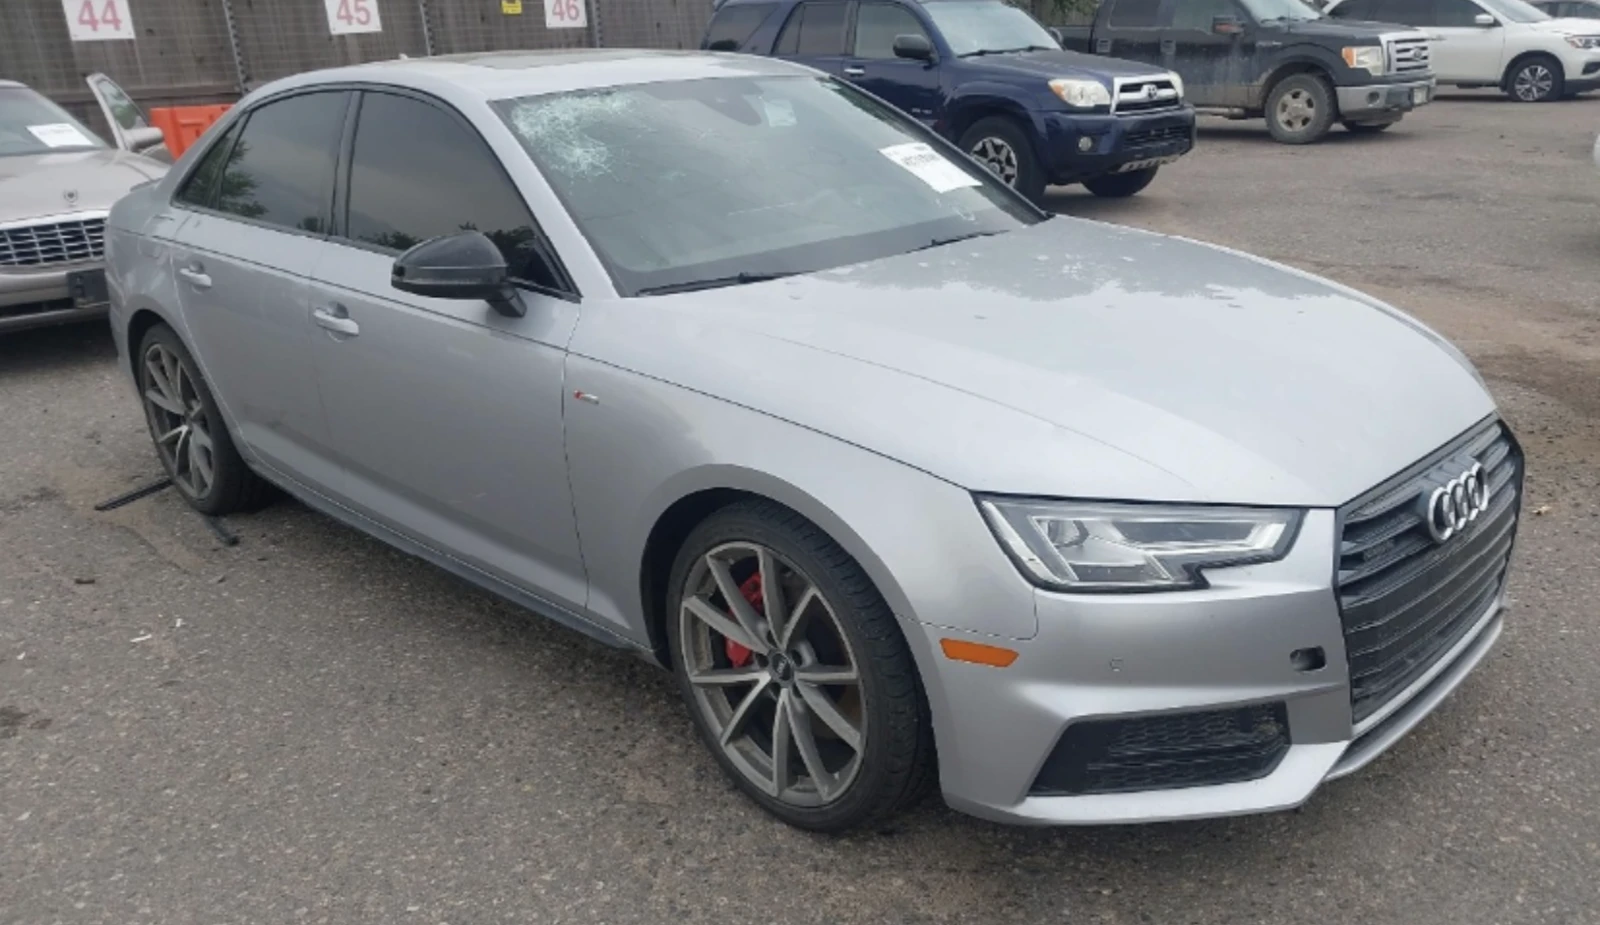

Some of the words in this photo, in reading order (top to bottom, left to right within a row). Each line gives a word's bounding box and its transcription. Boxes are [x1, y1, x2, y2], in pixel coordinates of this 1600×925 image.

[79, 0, 122, 31] 44
[336, 0, 371, 26] 45
[552, 0, 579, 21] 46
